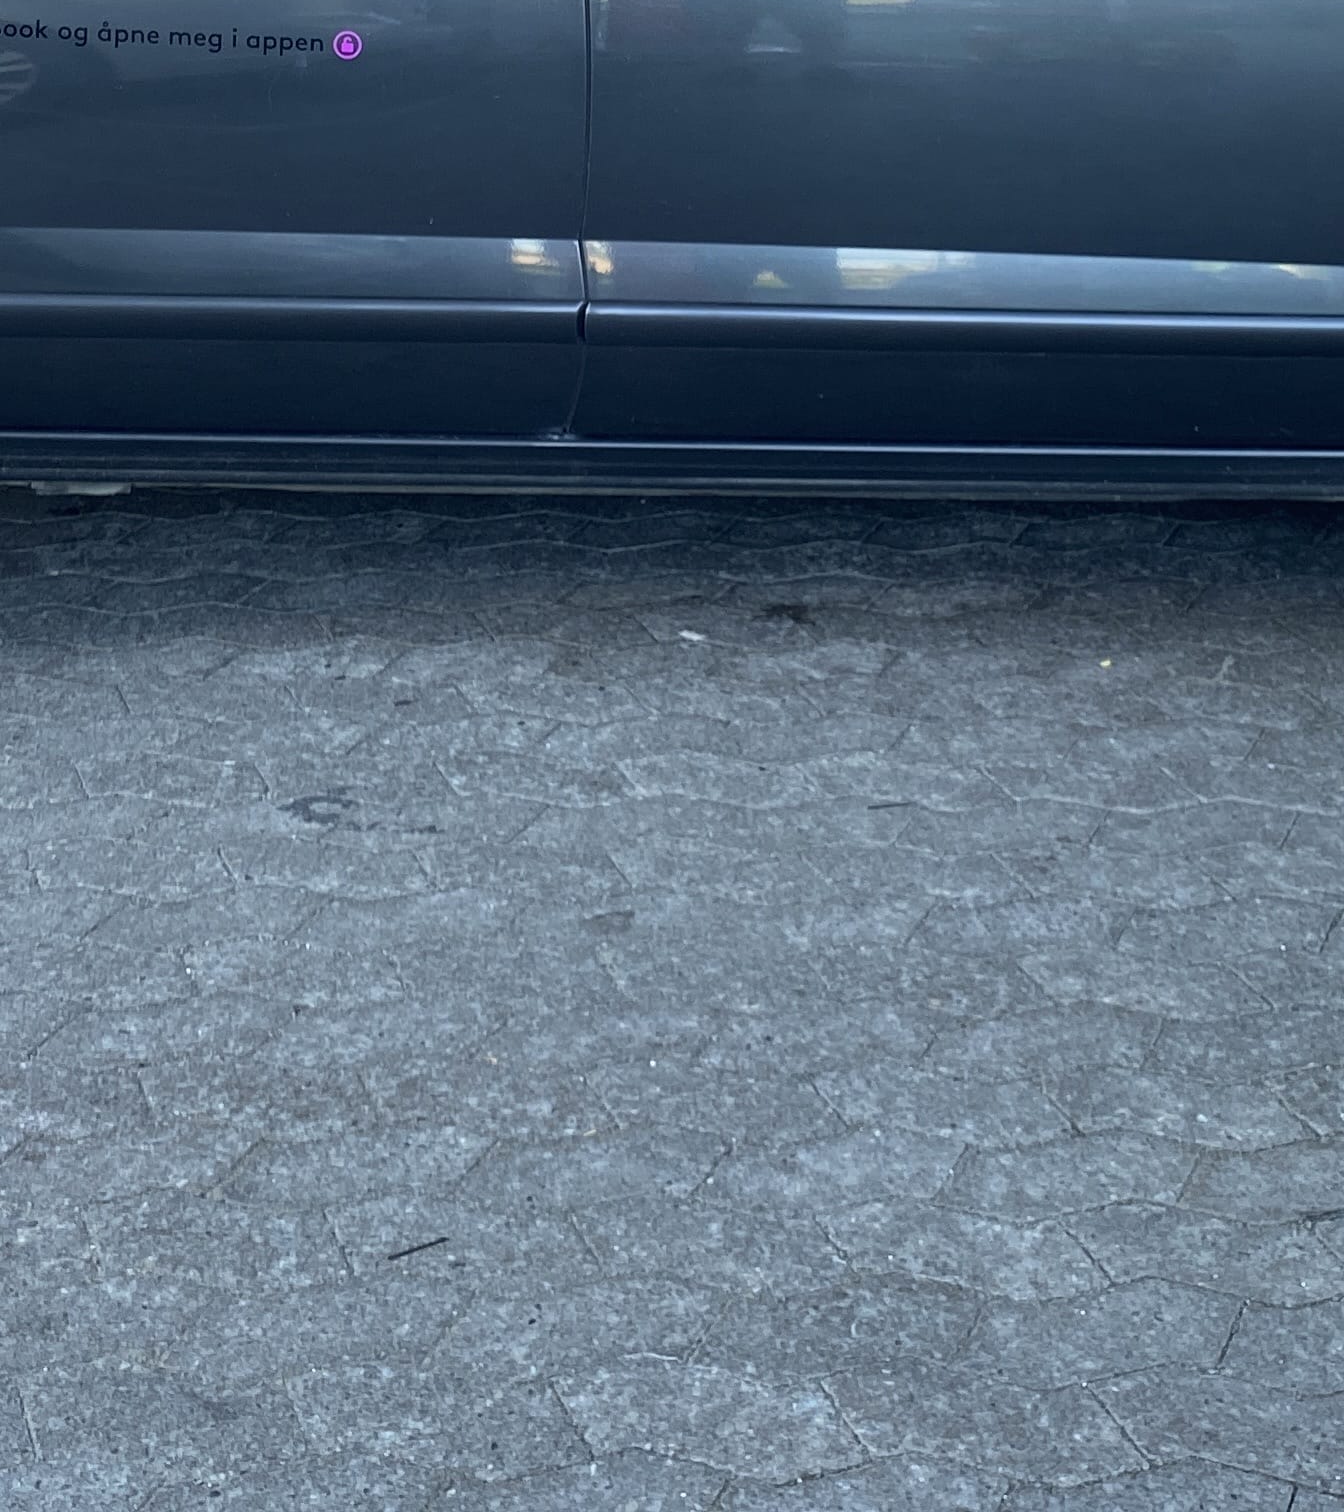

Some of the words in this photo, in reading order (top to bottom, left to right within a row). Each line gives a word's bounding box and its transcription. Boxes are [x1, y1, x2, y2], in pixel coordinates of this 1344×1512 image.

[57, 25, 88, 48] og
[98, 20, 159, 48] åpne
[169, 31, 222, 53] meg
[231, 28, 238, 49] i
[246, 34, 324, 57] appen
